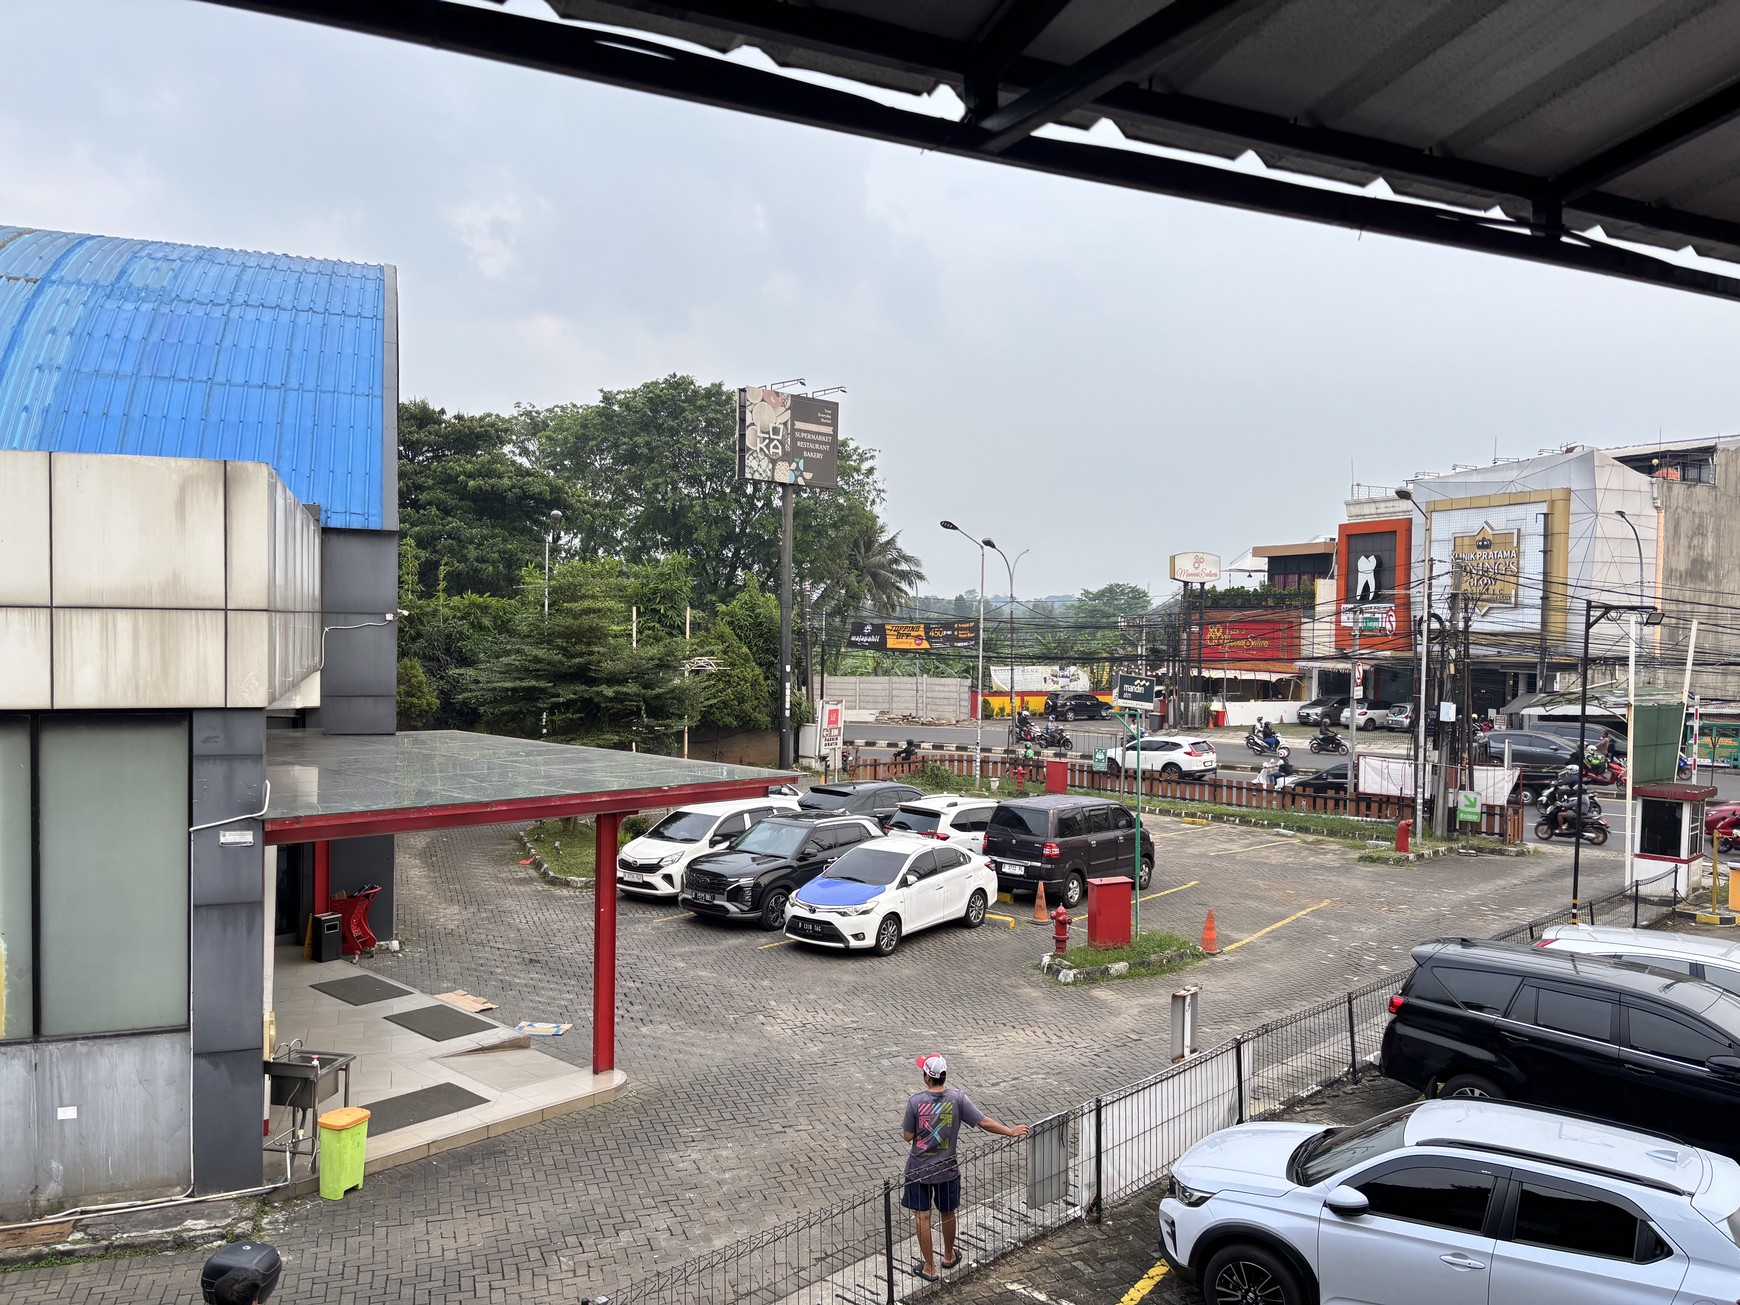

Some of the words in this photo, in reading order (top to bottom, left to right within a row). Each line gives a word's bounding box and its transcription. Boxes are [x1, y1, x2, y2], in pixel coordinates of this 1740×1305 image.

[795, 431, 833, 443] SUPERMARKET
[797, 441, 830, 451] RESTAURANT
[803, 451, 824, 459] BAKERY
[1476, 550, 1517, 560] PRATAMA
[851, 635, 880, 643] majapahit
